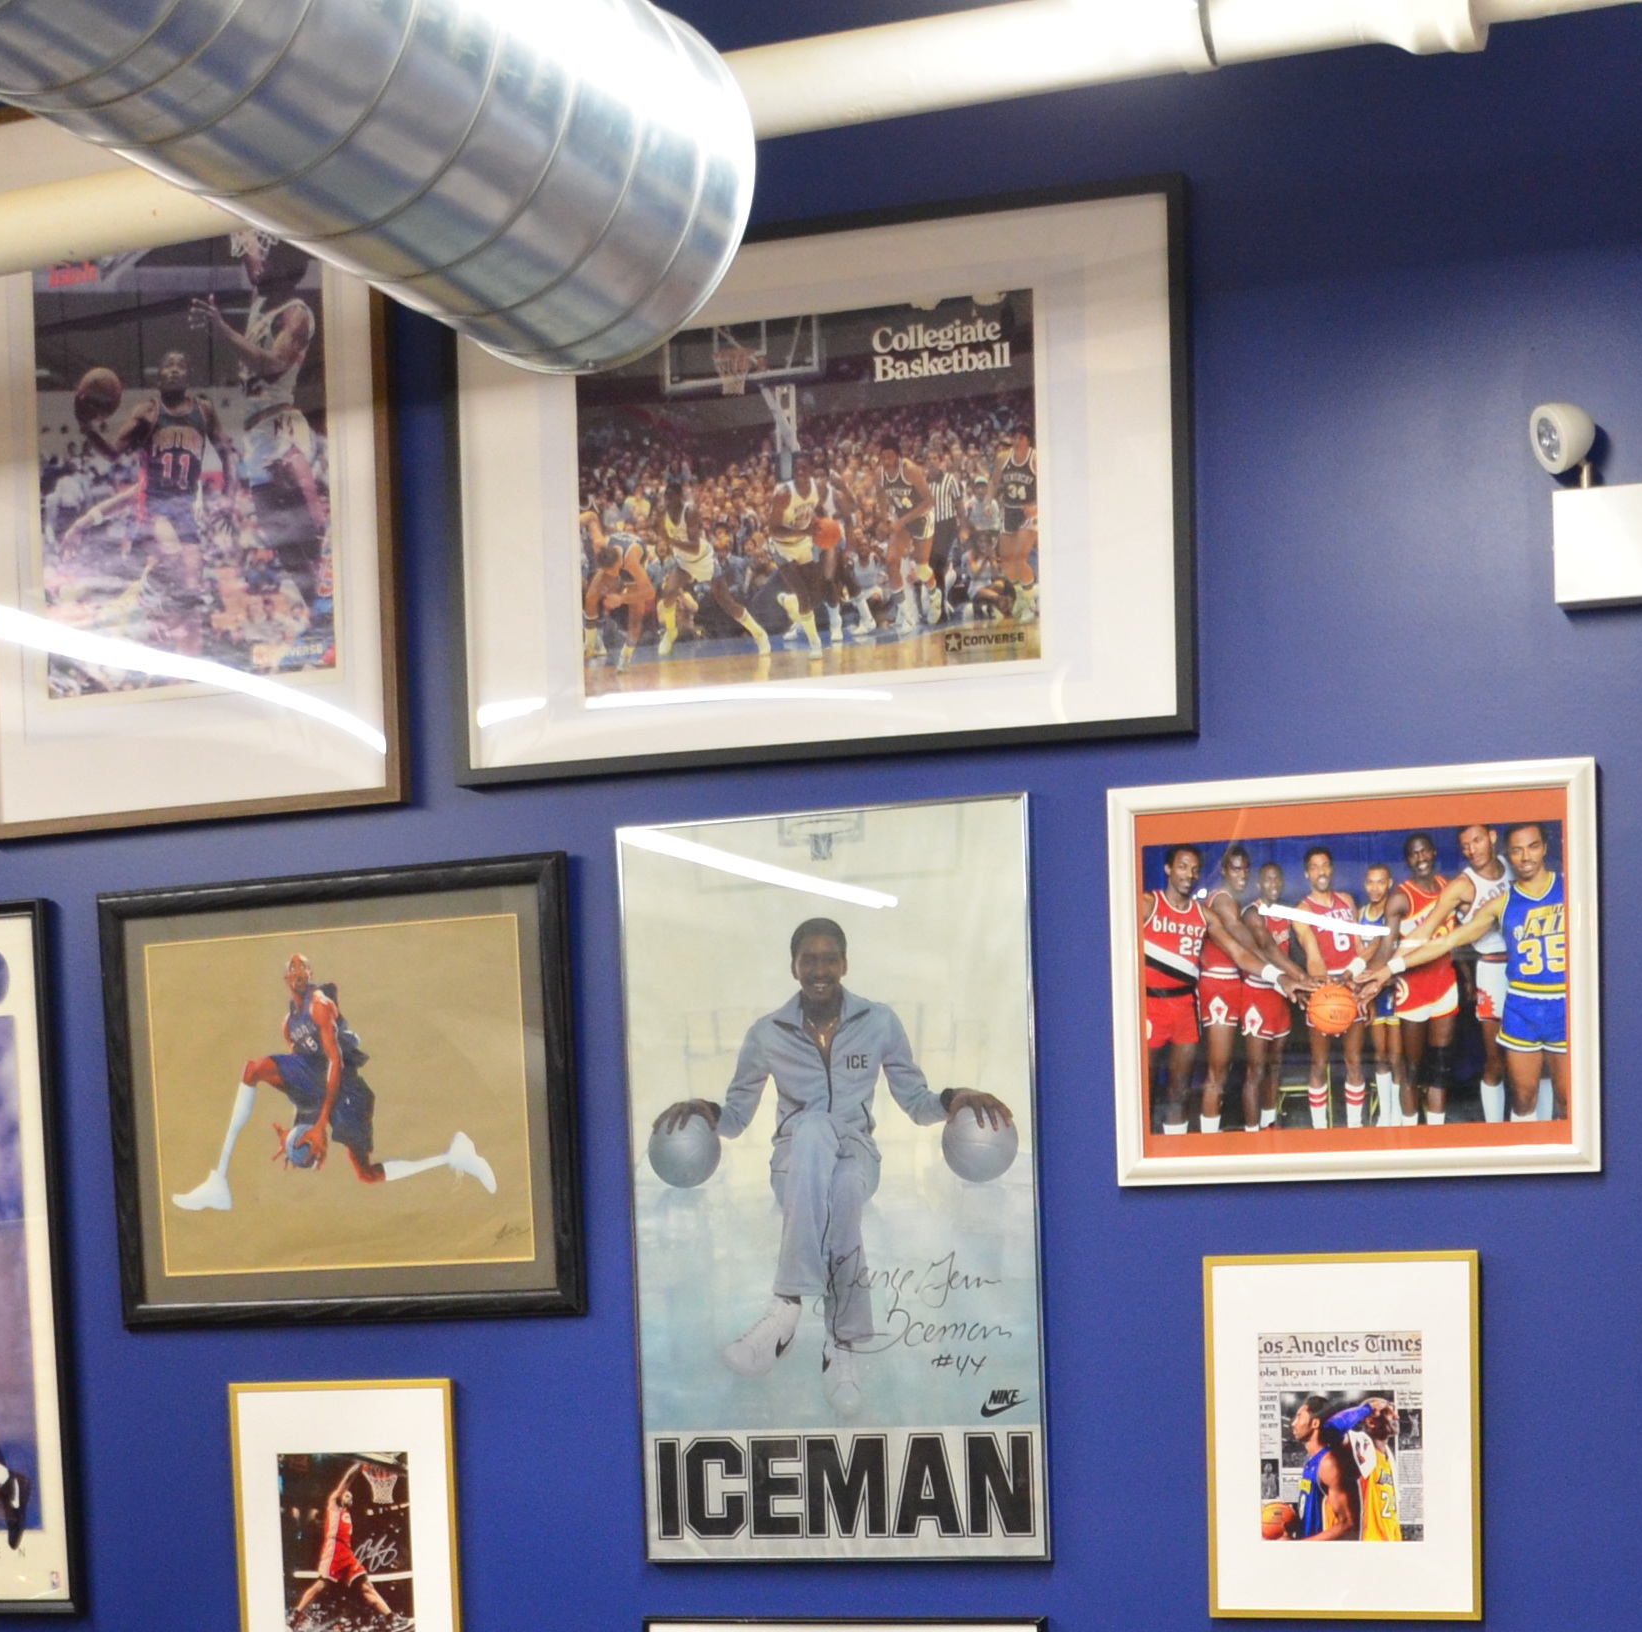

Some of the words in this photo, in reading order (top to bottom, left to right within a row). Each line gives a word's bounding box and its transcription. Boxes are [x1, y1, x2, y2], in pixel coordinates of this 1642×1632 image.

[872, 318, 1002, 353] Collegiate
[873, 341, 1011, 382] Basketball
[161, 452, 190, 490] 11
[1008, 484, 1027, 500] 34
[963, 632, 1025, 646] CONVERSE
[1517, 934, 1565, 975] 35
[1286, 1335, 1360, 1357] Angeles
[1364, 1334, 1422, 1353] Times
[1281, 1367, 1318, 1379] Bryant
[1326, 1366, 1347, 1376] The
[1351, 1365, 1381, 1376] Black
[988, 1389, 1020, 1405] NIKE
[655, 1432, 1037, 1539] ICEMAN
